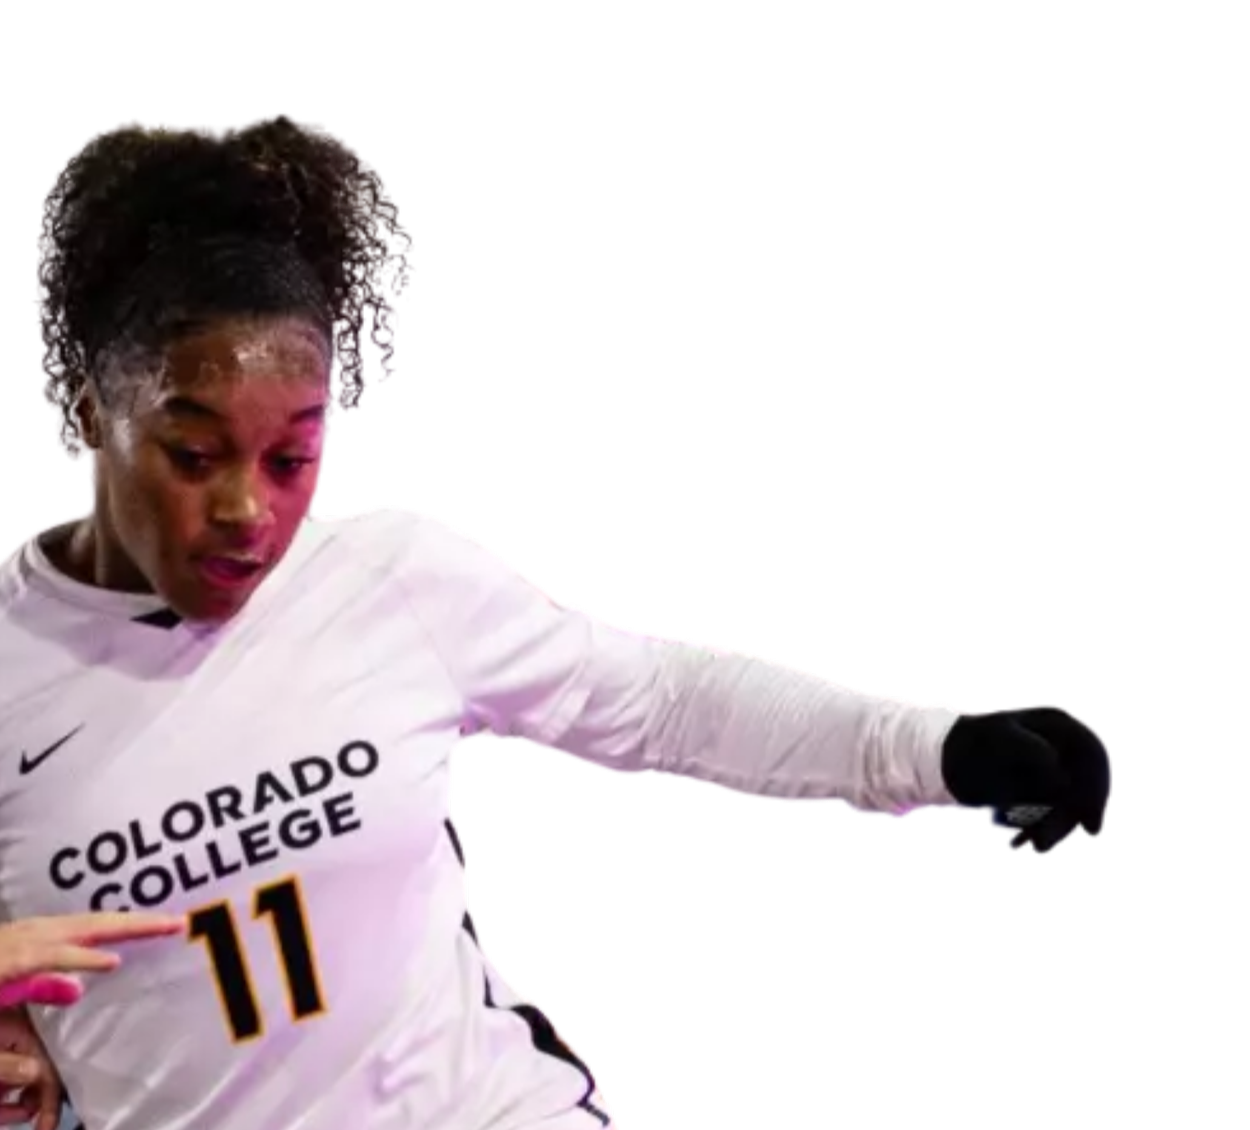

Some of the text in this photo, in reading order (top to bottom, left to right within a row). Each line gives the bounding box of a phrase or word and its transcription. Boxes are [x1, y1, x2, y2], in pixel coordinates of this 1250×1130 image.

[49, 740, 380, 891] COLORADO
[90, 792, 362, 913] COLLEGE
[187, 874, 327, 1044] 11
